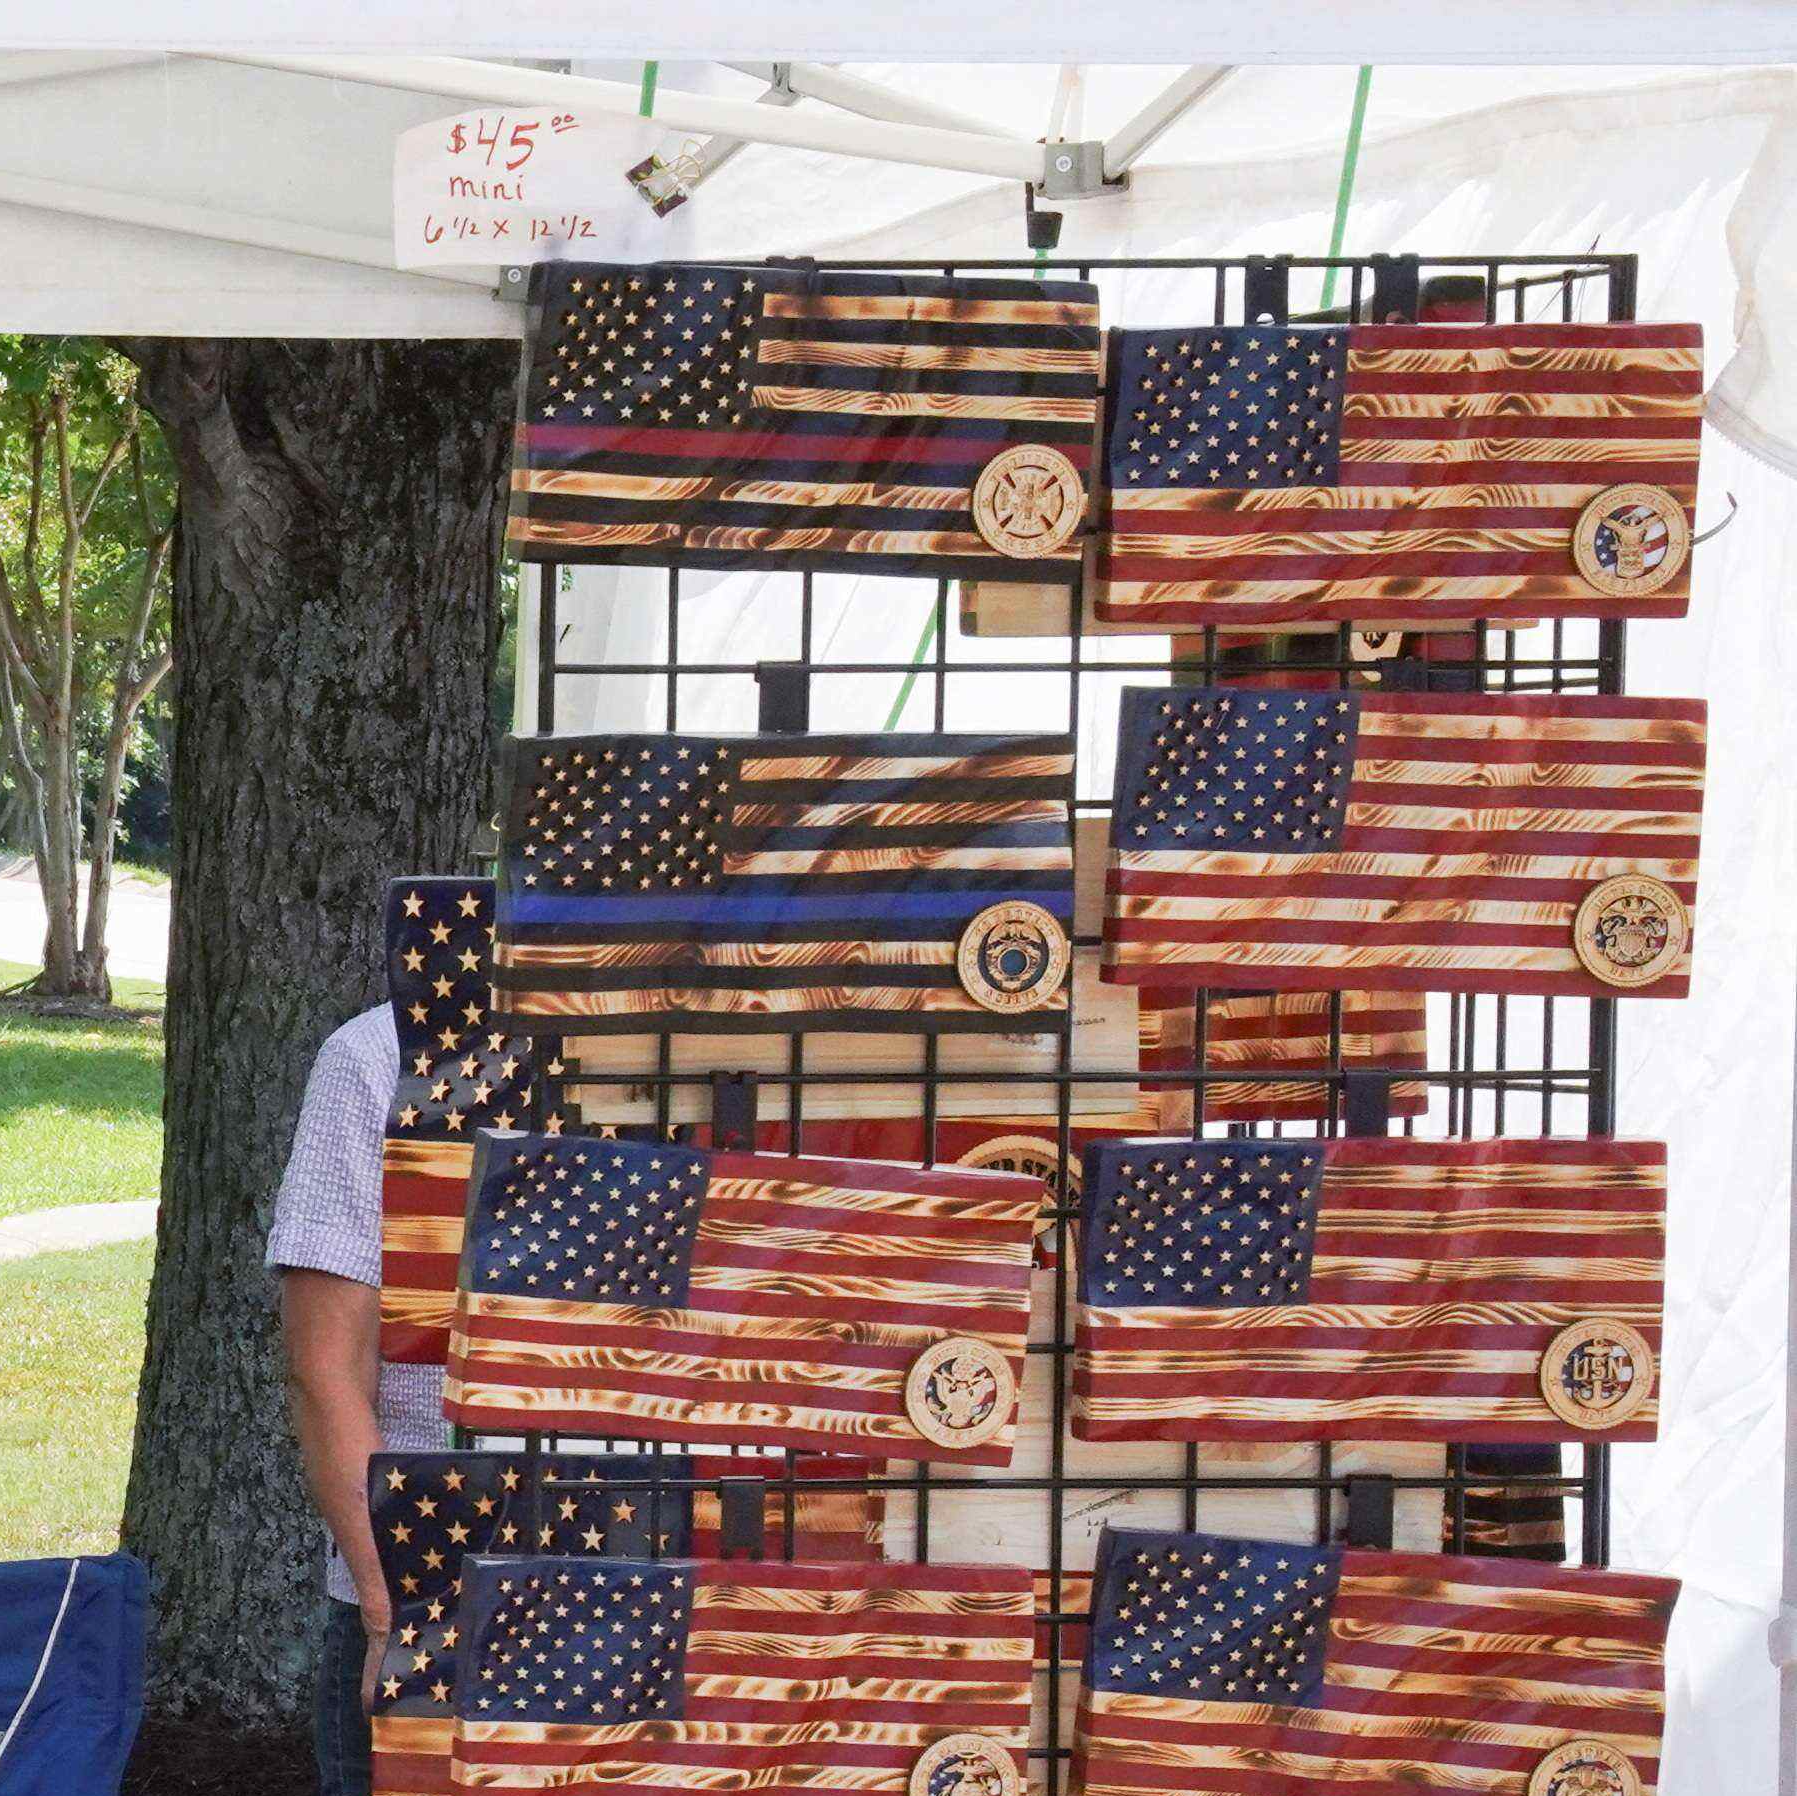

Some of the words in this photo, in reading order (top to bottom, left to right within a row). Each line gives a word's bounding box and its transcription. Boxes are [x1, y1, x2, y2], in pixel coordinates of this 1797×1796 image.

[446, 116, 540, 171] $45
[449, 174, 524, 200] mini
[1572, 1357, 1623, 1380] USN
